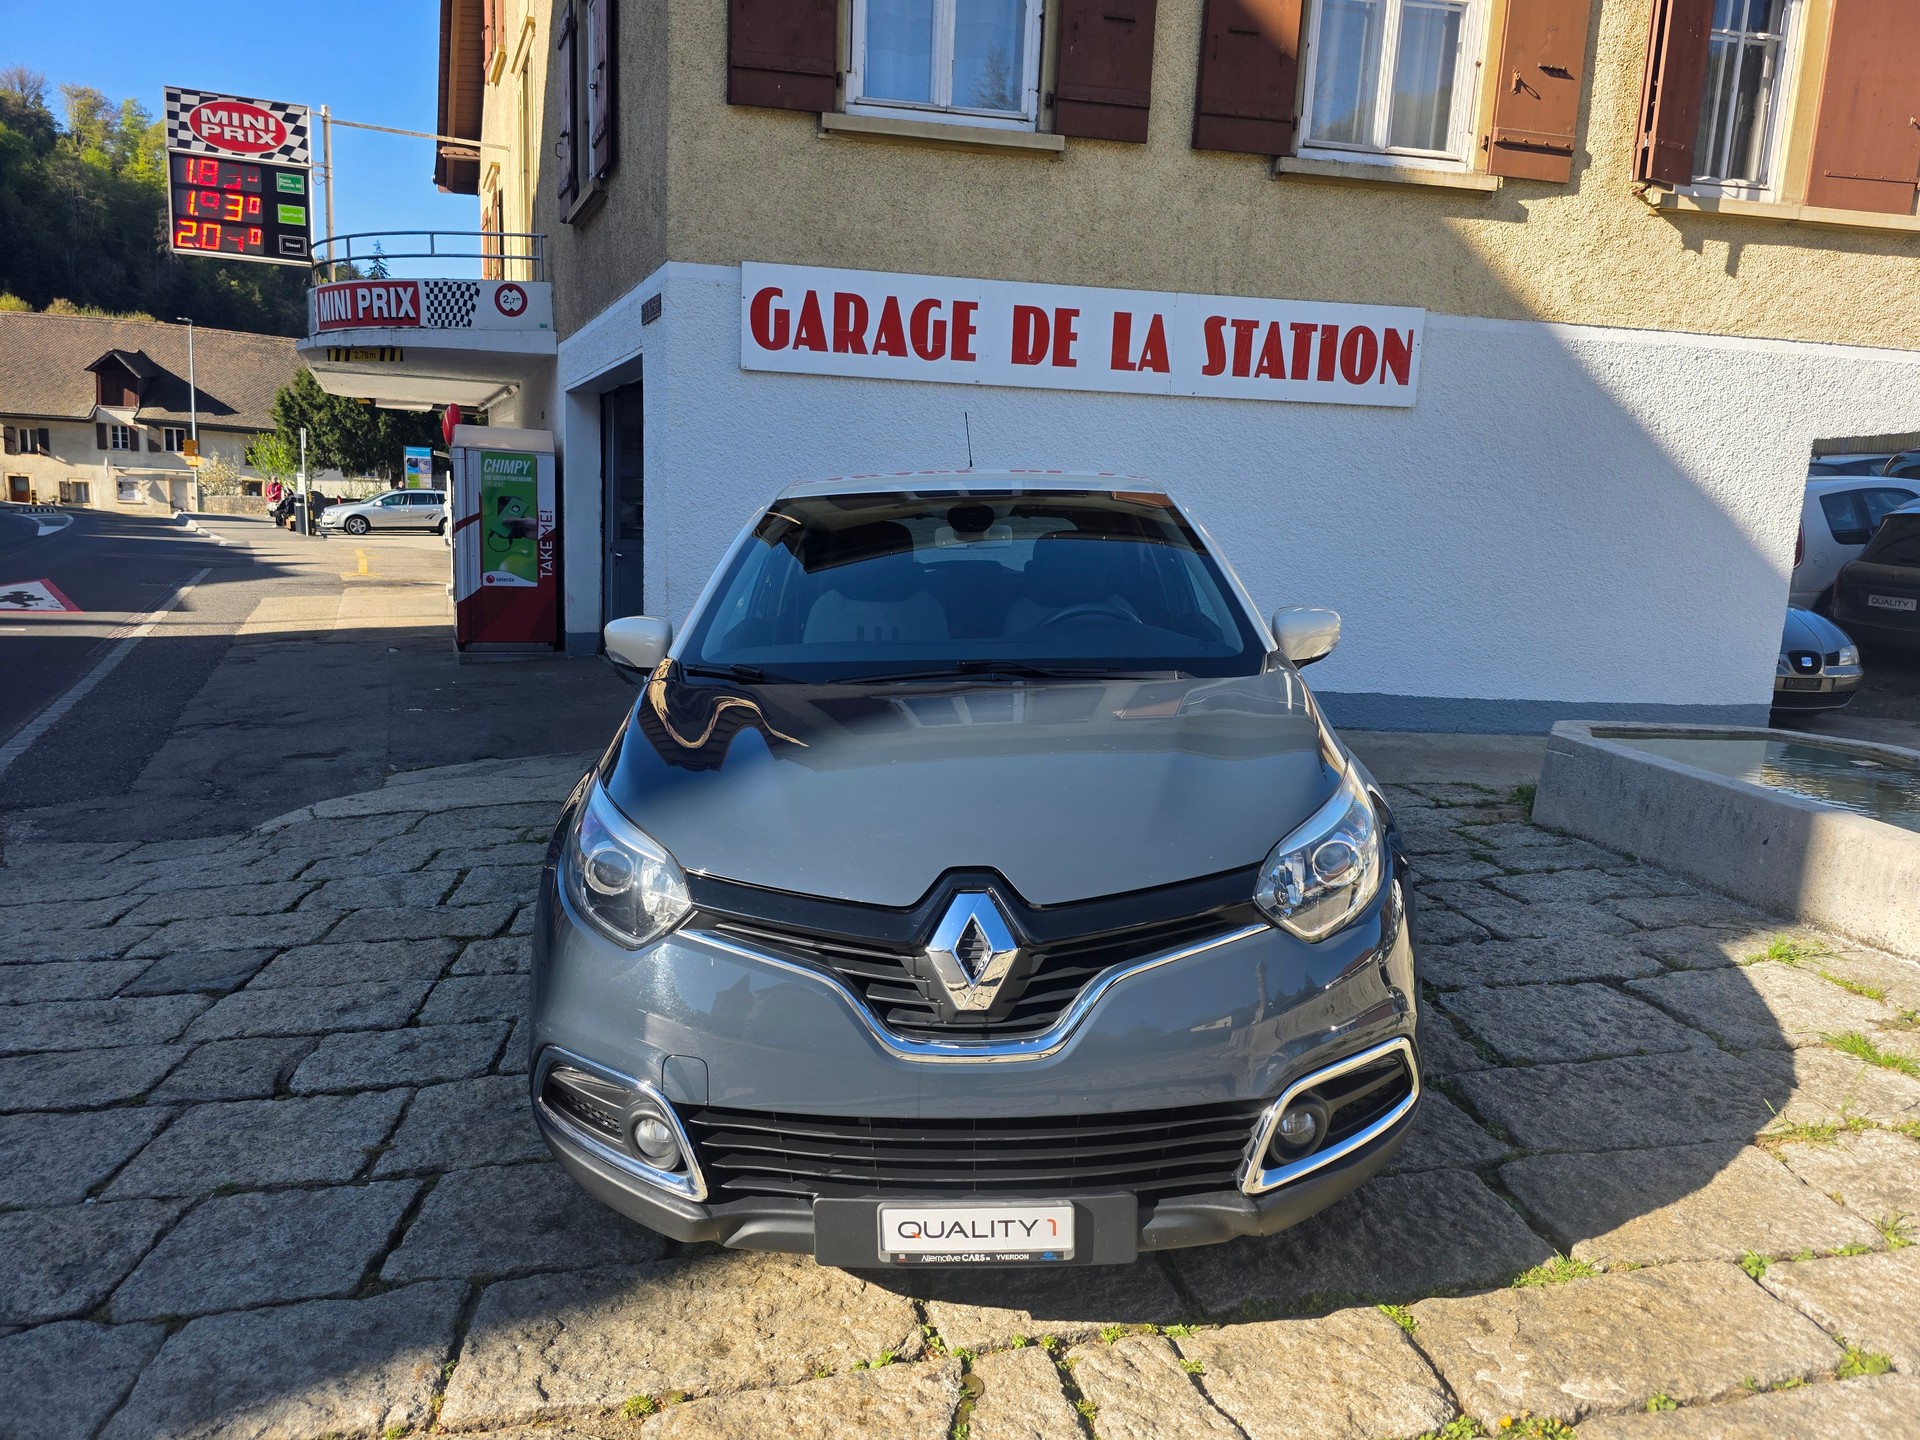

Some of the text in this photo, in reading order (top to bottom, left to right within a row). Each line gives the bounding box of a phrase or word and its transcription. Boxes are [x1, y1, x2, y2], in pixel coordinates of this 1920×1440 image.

[200, 108, 276, 132] MINI
[201, 123, 278, 146] PRIX
[319, 287, 416, 323] MINI PRIX
[749, 286, 1415, 386] GARAGE DE LA STATION
[483, 458, 531, 475] CHIMPY
[540, 510, 553, 578] TAKE ME!
[1871, 597, 1909, 608] QUALITY
[897, 1218, 1057, 1239] QUALITY 1
[961, 1253, 986, 1262] CARS
